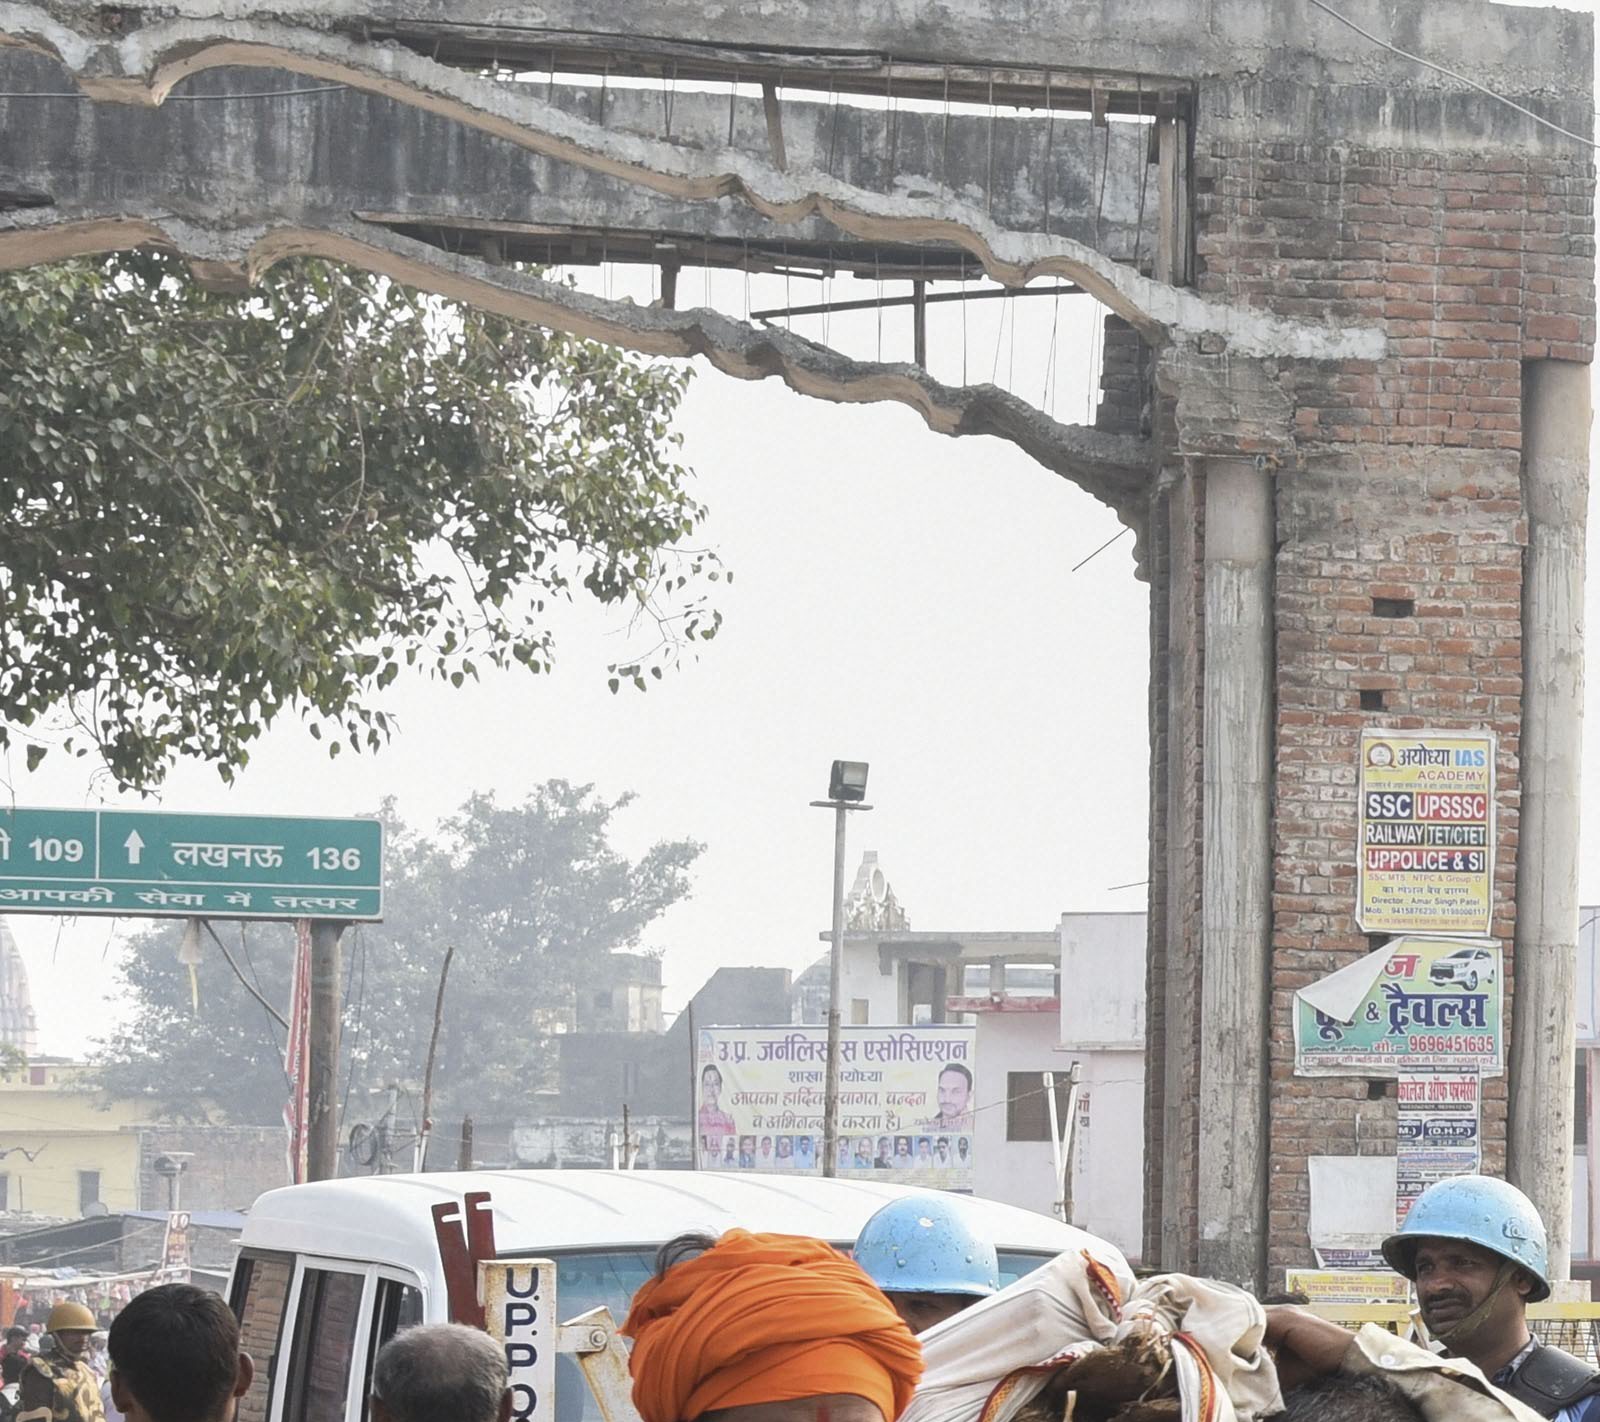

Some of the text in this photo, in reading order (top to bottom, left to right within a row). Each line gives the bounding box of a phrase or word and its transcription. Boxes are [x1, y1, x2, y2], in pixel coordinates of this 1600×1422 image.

[1398, 743, 1485, 767] अयोध्या IAS
[1418, 771, 1484, 781] ACADEMY
[1368, 794, 1485, 818] SSC UPSSSC
[1366, 824, 1424, 844] RAILWAY
[28, 838, 83, 863] 109
[171, 841, 361, 871] लखनऊ 136
[1368, 850, 1484, 870] UPPOLICE & SI
[135, 888, 205, 907] सेवा
[224, 890, 251, 907] में
[272, 896, 360, 910] तत्पर
[1366, 1001, 1380, 1021] &
[1380, 983, 1488, 1035] ट्रैवल्स
[718, 1039, 750, 1064] उ.प्र.
[864, 1033, 968, 1063] एसोसिएशन
[1410, 1035, 1494, 1052] 9696451635
[788, 1069, 882, 1084] शाखा योध्या
[730, 1091, 778, 1107] आपका
[766, 1109, 826, 1131] अभिनन्द
[1428, 1126, 1471, 1136] (D.H.P.)
